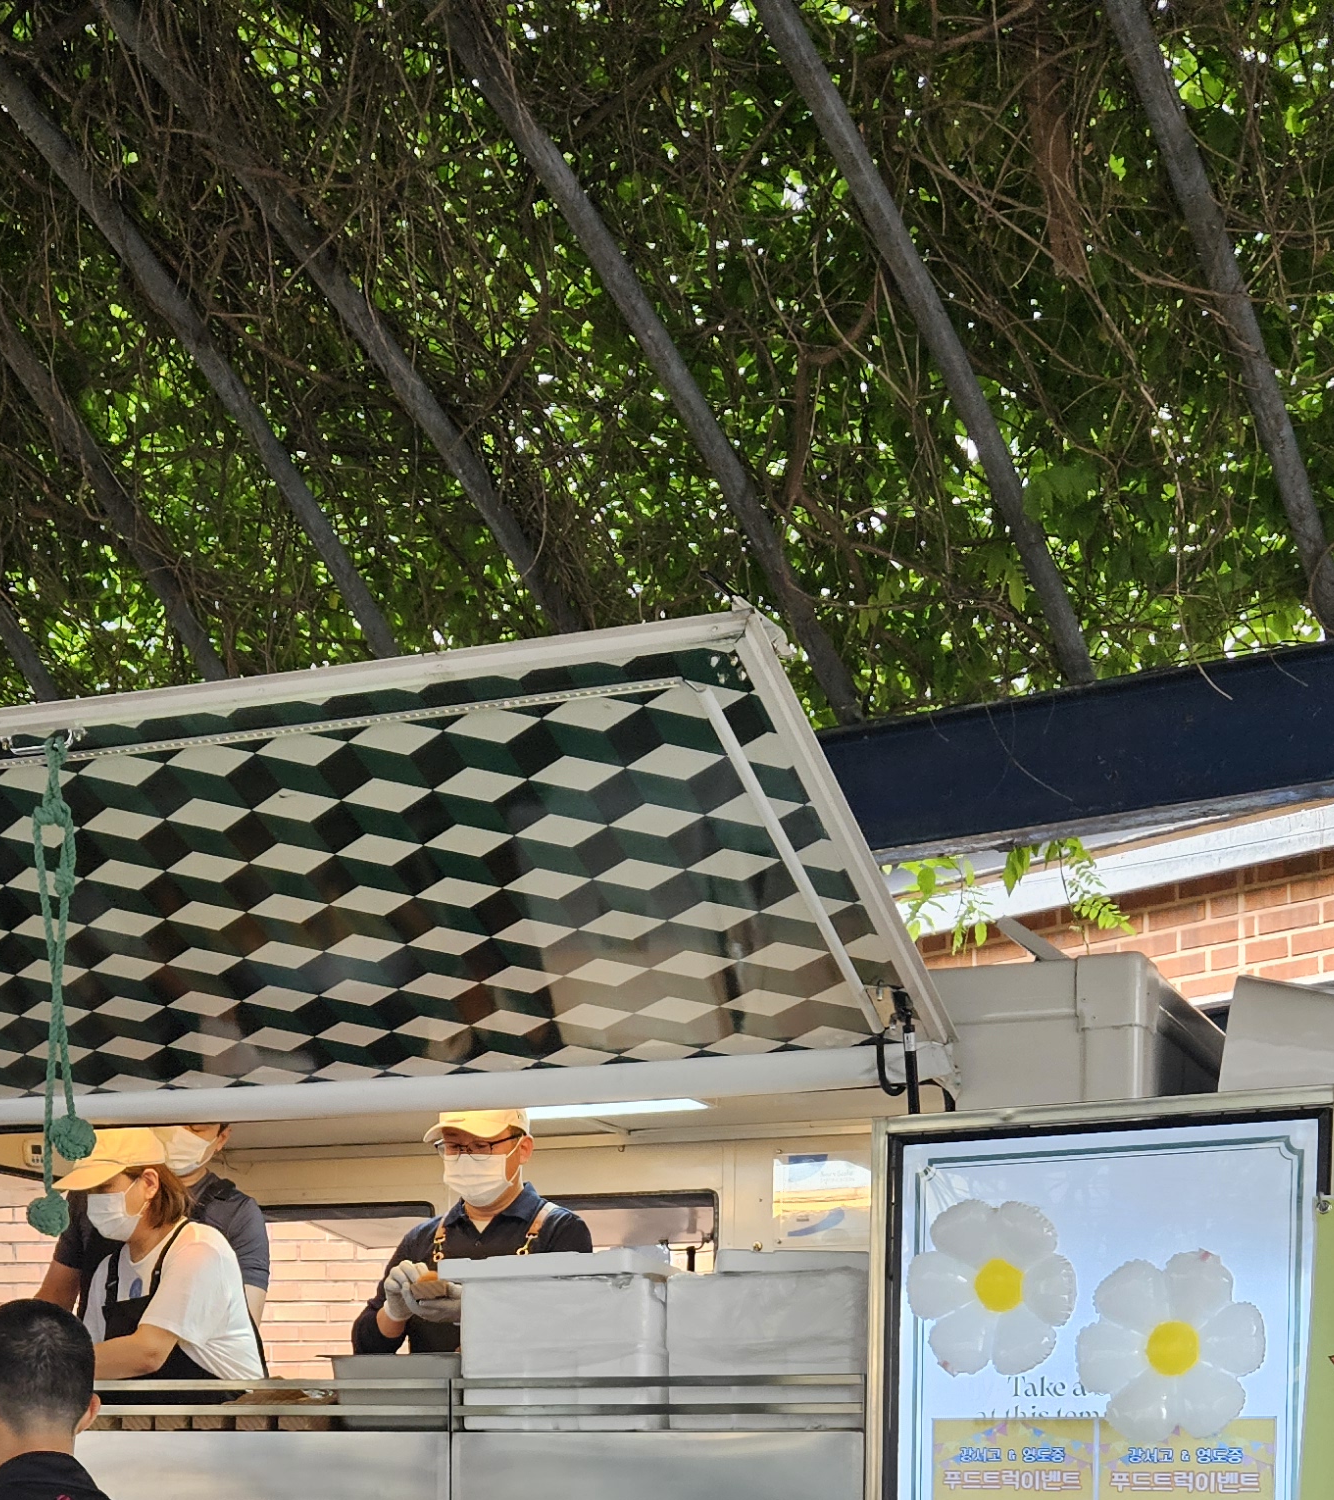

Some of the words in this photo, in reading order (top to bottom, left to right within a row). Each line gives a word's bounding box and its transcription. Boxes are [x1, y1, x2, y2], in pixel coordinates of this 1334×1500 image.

[1007, 1376, 1066, 1397] Take
[959, 1447, 1001, 1463] 강서고
[1128, 1447, 1174, 1463] 강서고
[943, 1469, 1082, 1491] 푸드트럭이벤트
[1110, 1471, 1261, 1493] 푸드트럭이벤트
